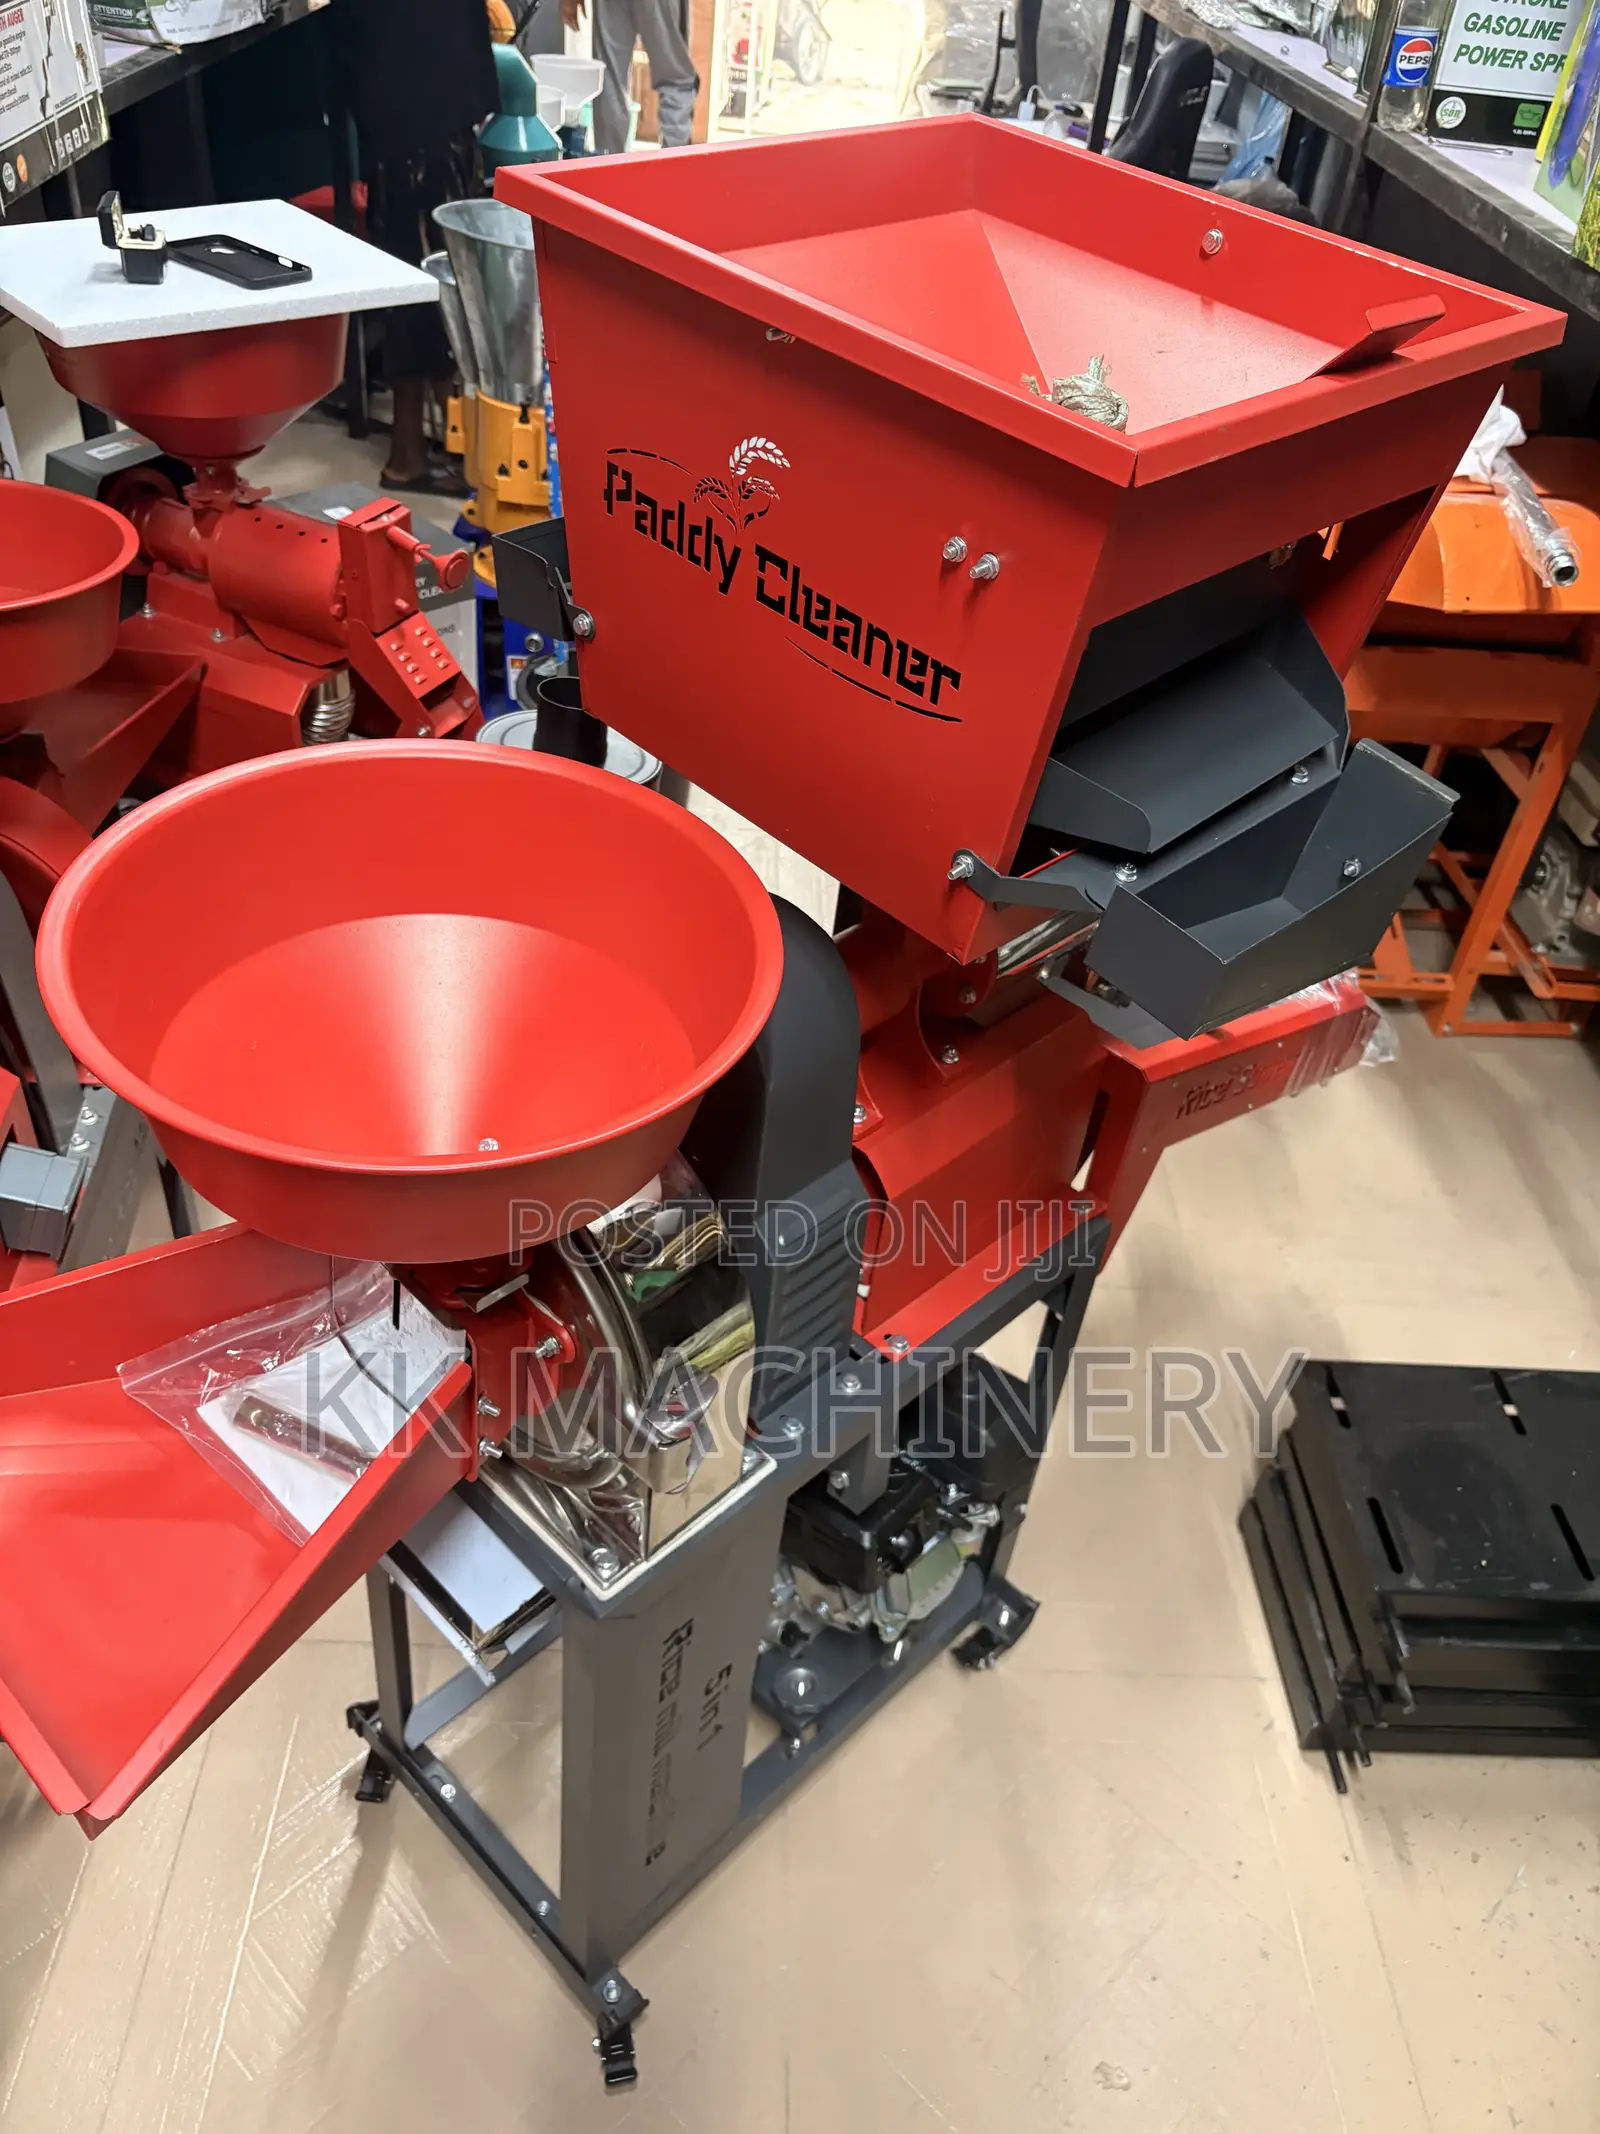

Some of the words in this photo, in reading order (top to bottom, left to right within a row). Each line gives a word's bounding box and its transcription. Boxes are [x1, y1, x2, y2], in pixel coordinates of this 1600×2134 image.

[6, 8, 24, 27] AUGER
[93, 4, 133, 17] ATTENTION
[1464, 12, 1567, 42] GASOLINE
[1399, 55, 1431, 65] PEPSI
[1453, 44, 1529, 70] POWER
[603, 460, 742, 596] Paddy
[754, 543, 962, 706] Cleaner
